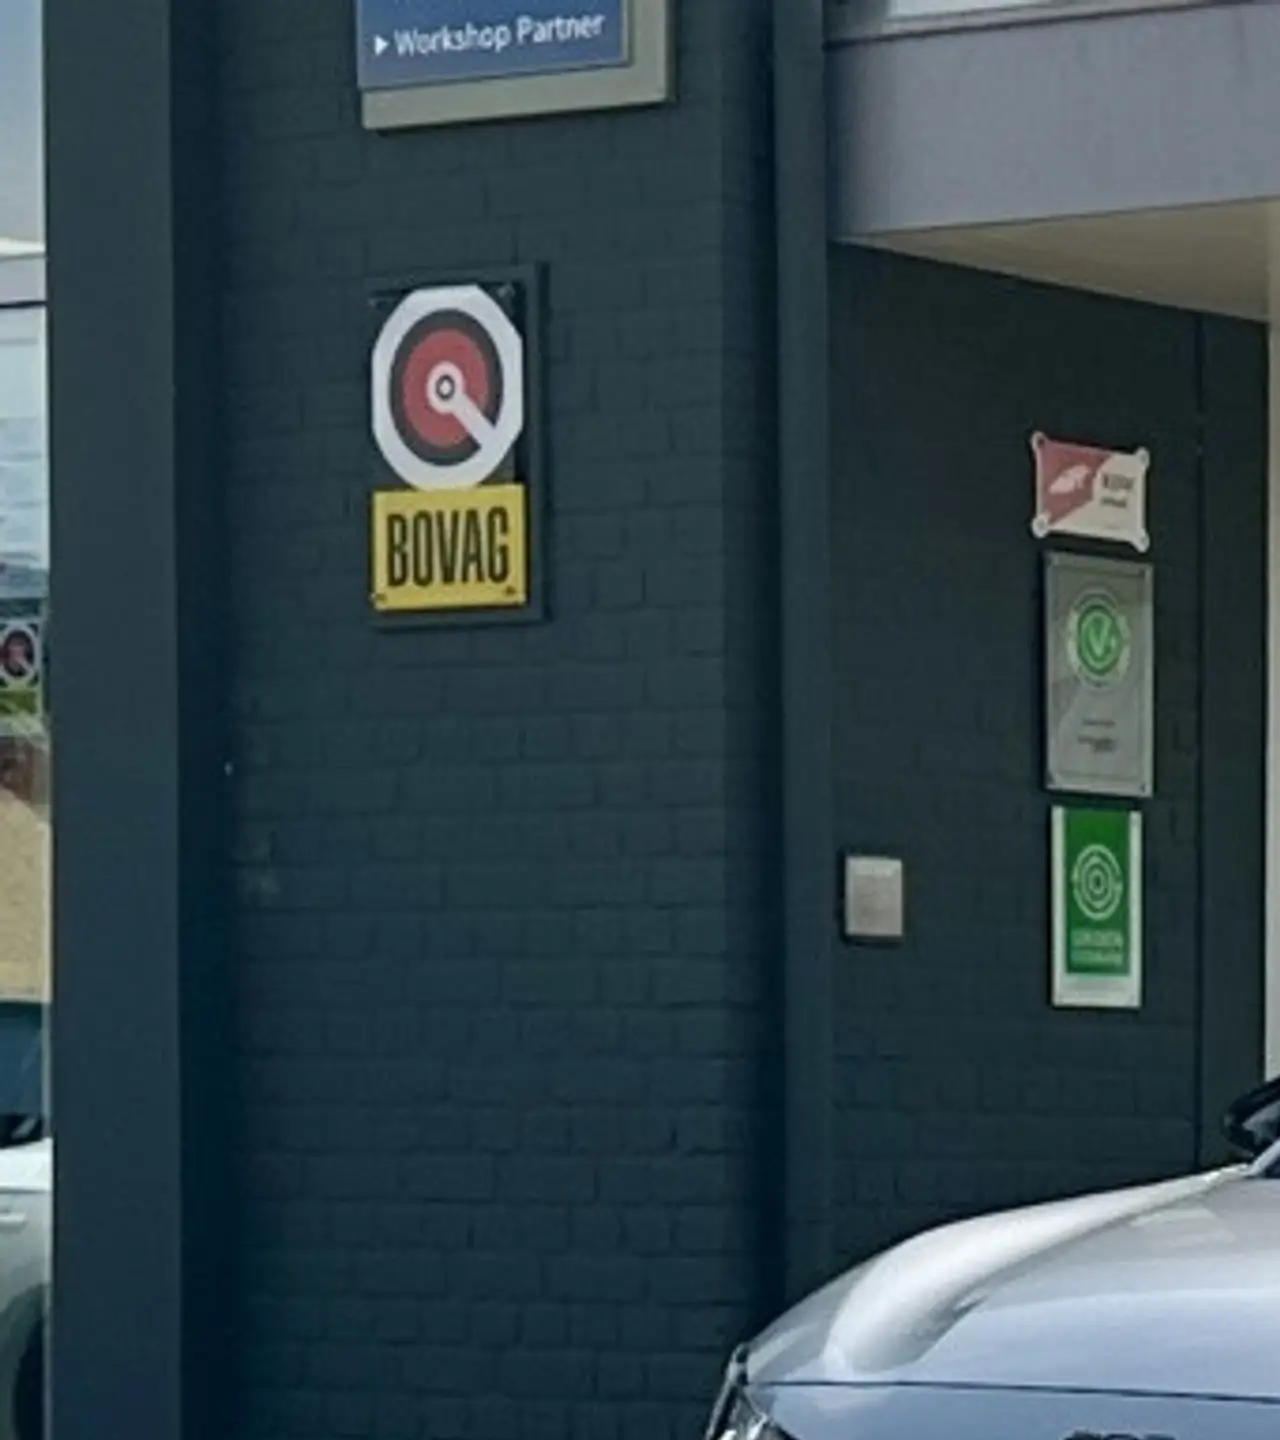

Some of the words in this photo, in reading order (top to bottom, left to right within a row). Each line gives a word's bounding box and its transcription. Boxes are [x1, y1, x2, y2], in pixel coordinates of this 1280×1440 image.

[394, 22, 511, 56] Workshop
[516, 14, 606, 46] Partner
[386, 506, 509, 587] BOVAG
